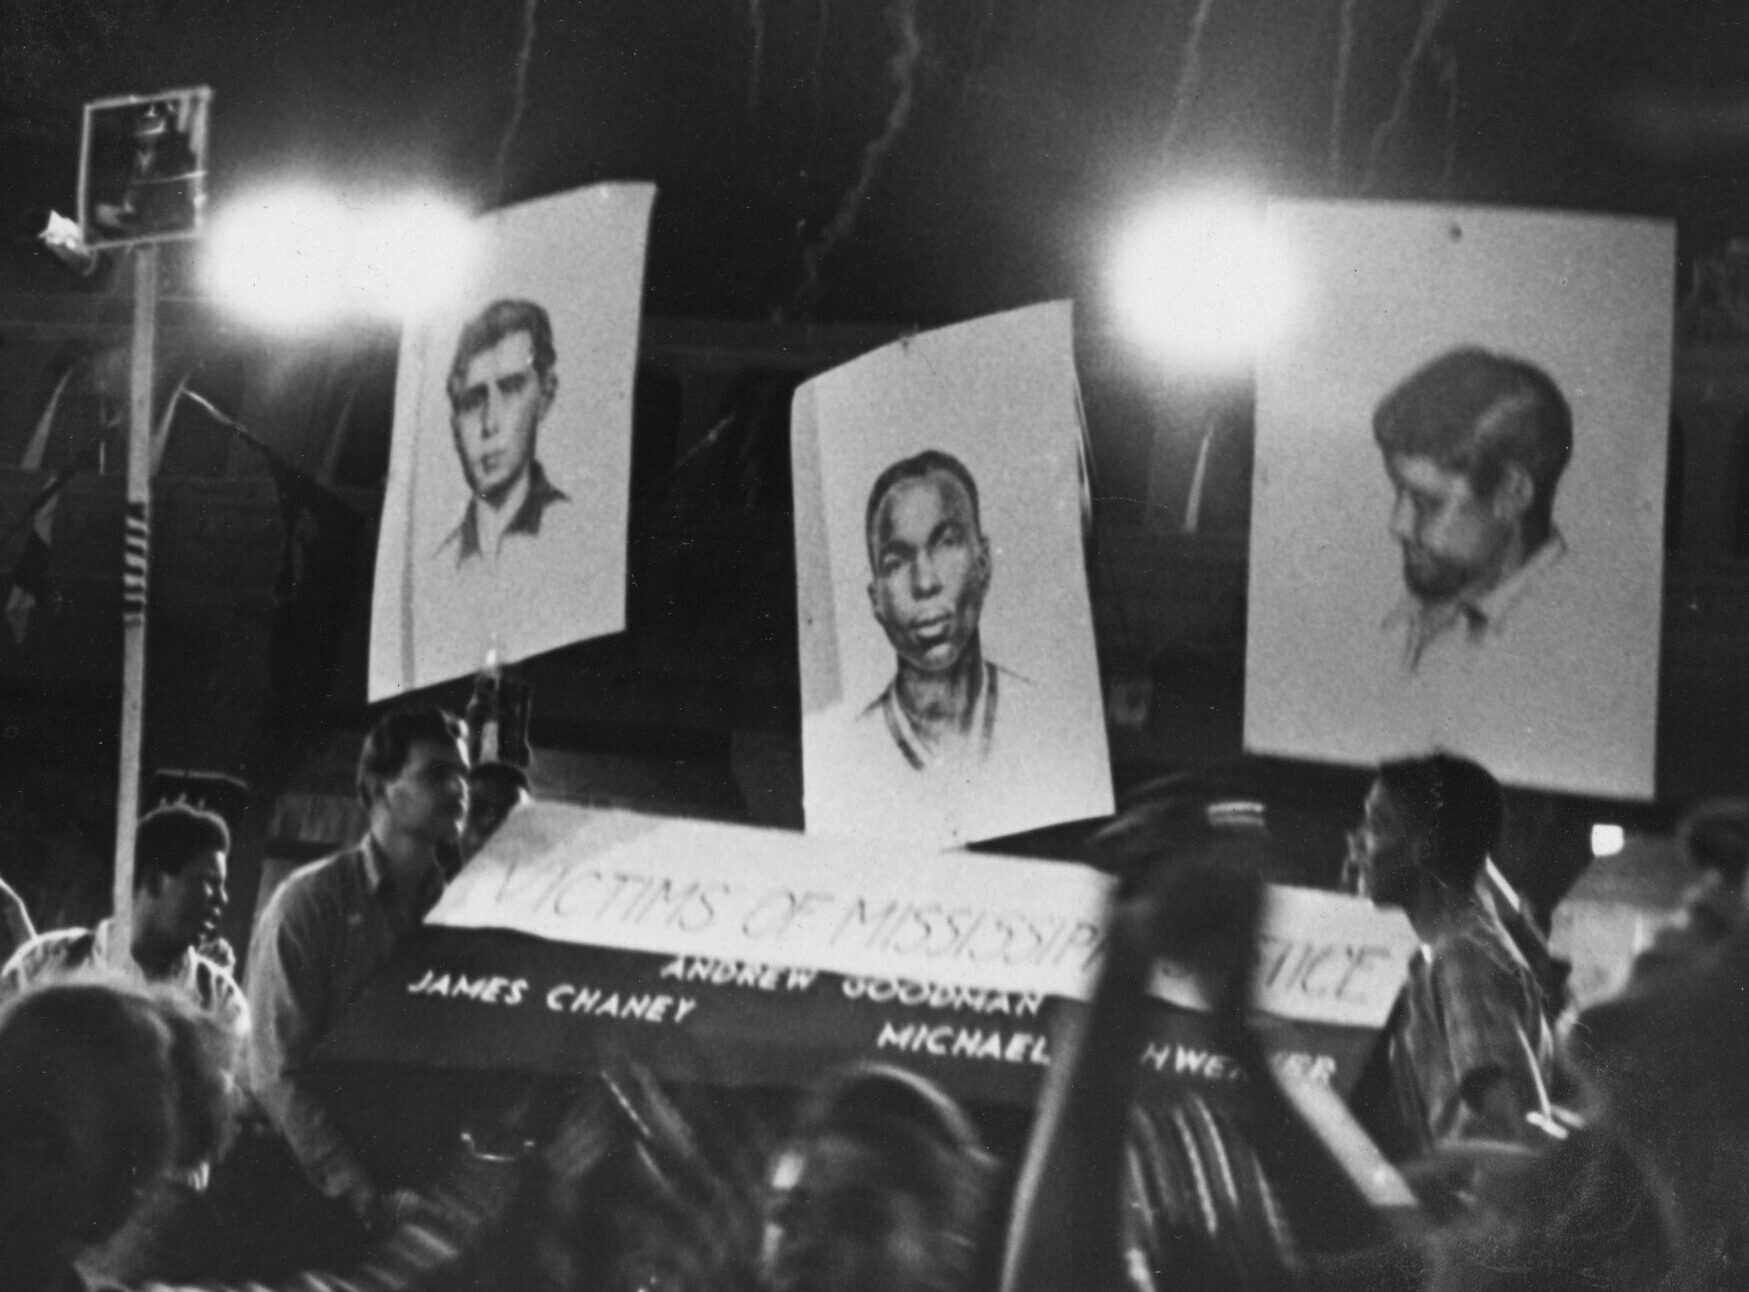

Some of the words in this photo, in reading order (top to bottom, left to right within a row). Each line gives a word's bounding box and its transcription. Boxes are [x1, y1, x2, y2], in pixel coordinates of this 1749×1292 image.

[495, 857, 731, 933] VICTIMS
[742, 887, 835, 941] OF
[830, 897, 1106, 971] MISSISSIP
[408, 969, 529, 1005] JAMES
[547, 984, 697, 1024] CHANEY
[660, 955, 820, 991] ANDREW
[877, 1020, 1051, 1066] MICHAEL
